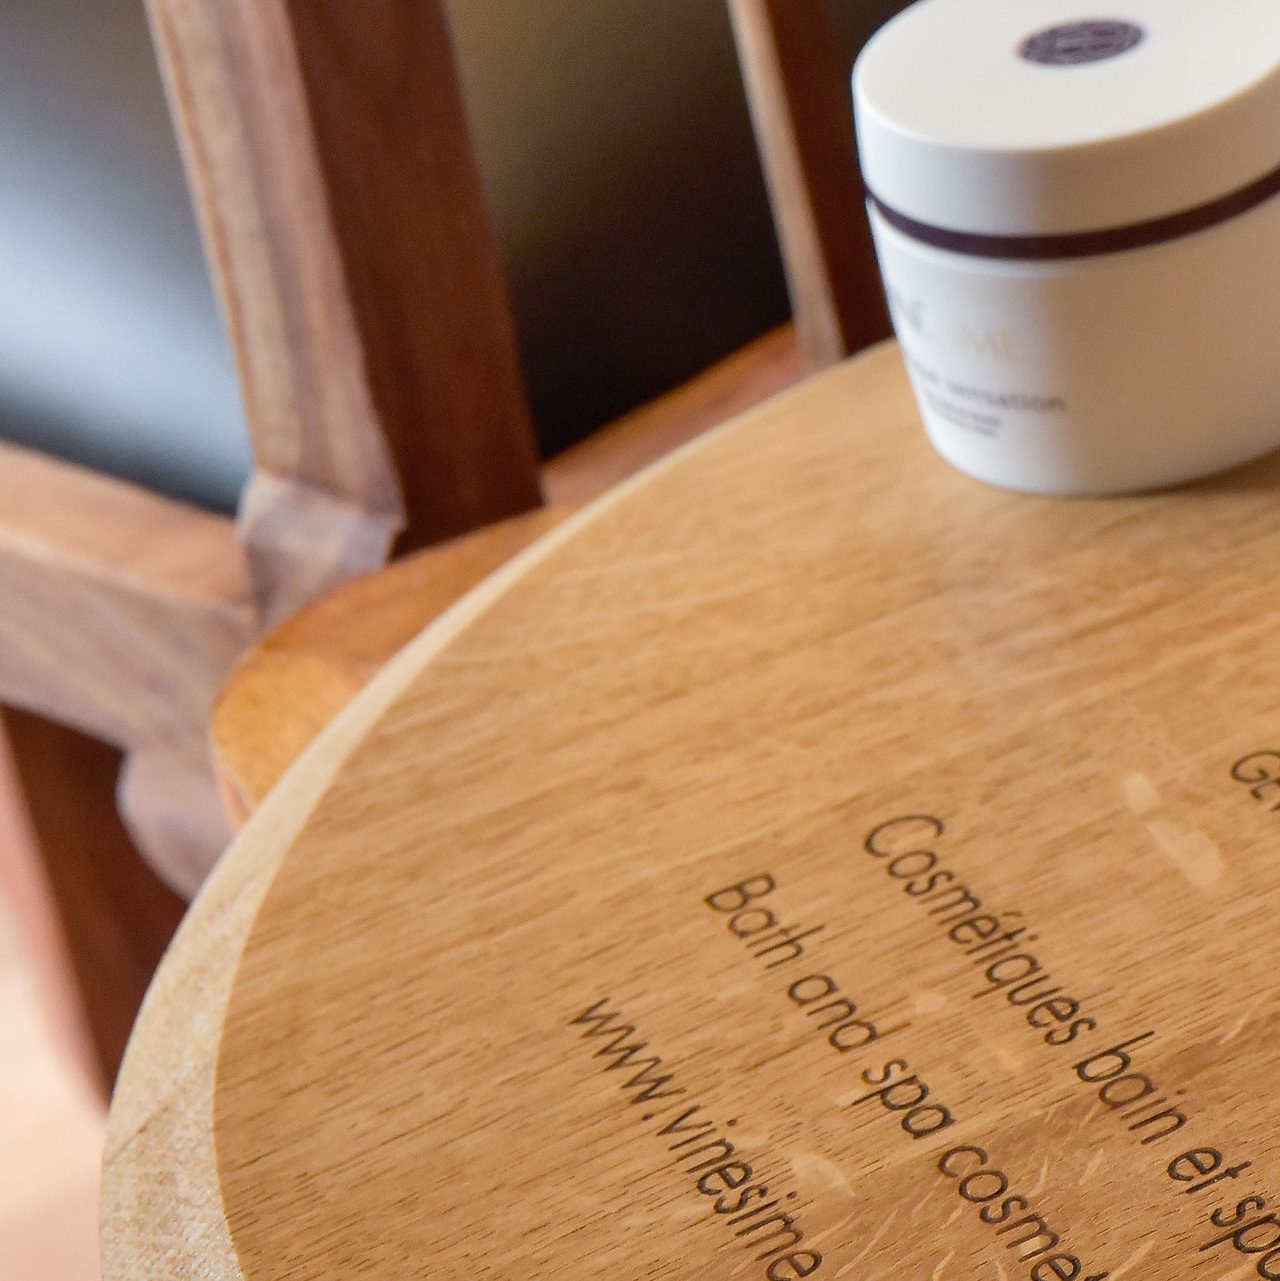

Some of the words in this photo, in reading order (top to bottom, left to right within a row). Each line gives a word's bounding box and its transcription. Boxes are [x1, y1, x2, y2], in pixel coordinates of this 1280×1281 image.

[704, 873, 824, 969] Bath
[788, 971, 910, 1054] and
[851, 1058, 957, 1140] spa
[938, 1144, 1110, 1281] cosme
[863, 813, 1098, 1047] Cosmétiques
[1072, 1030, 1188, 1145] bain
[1166, 1145, 1258, 1194] et
